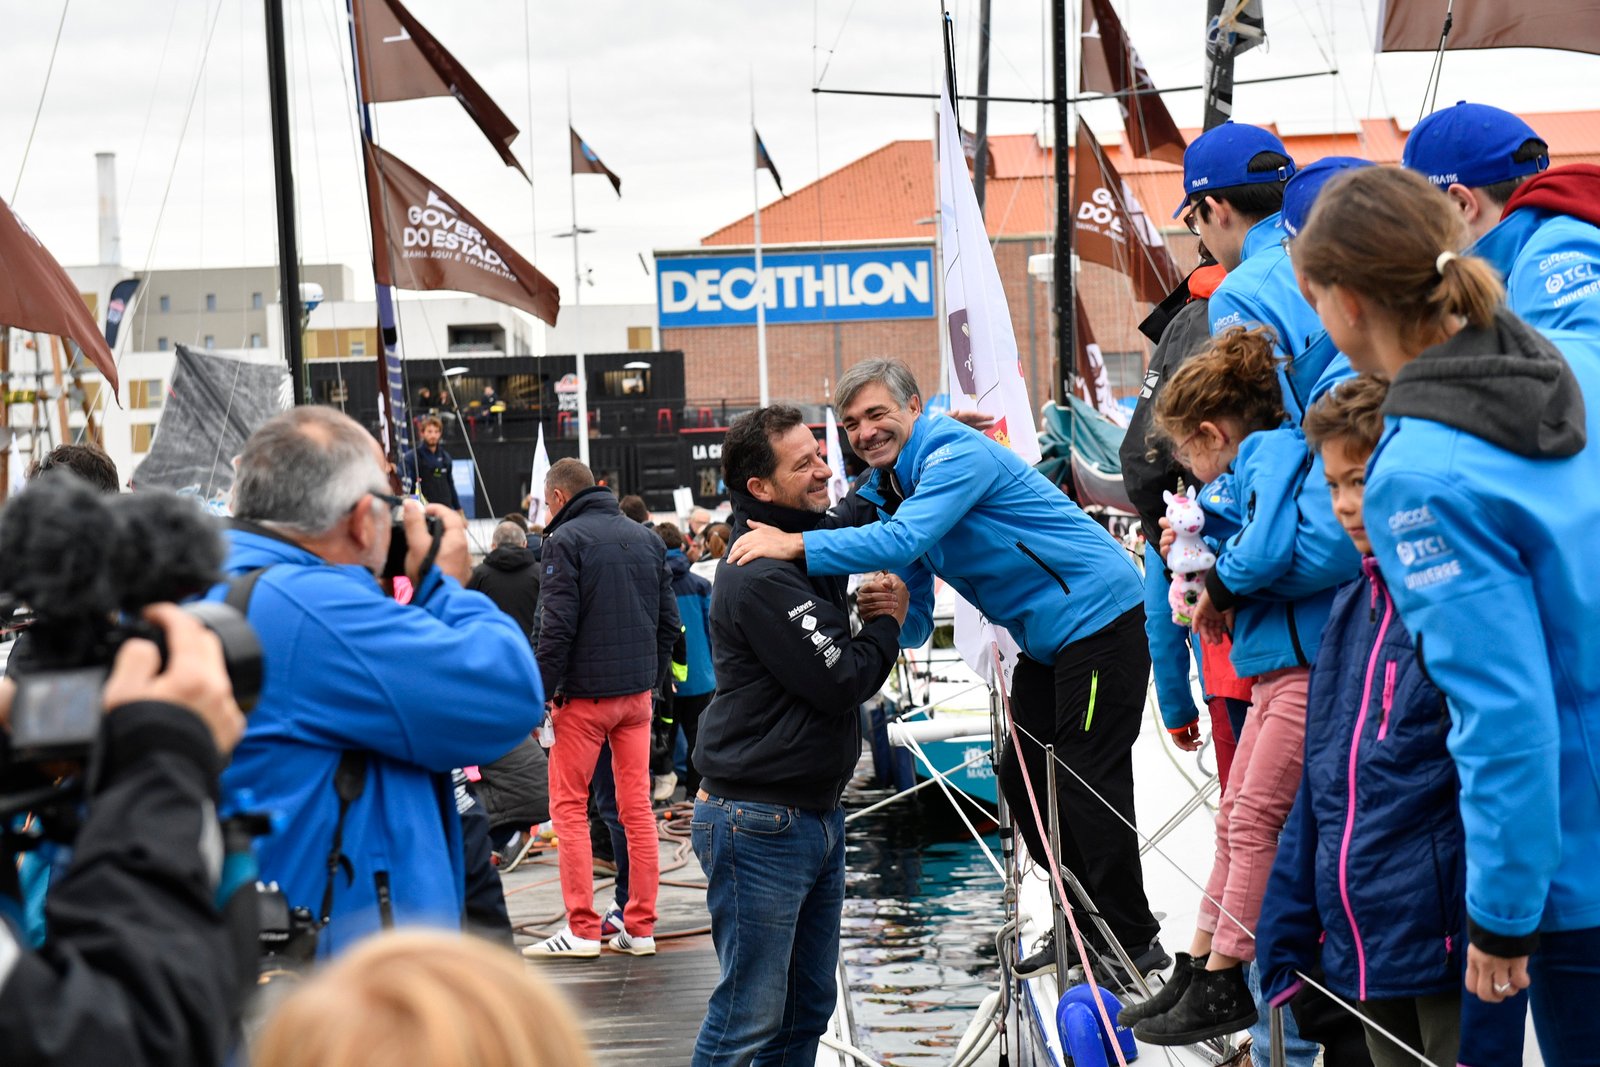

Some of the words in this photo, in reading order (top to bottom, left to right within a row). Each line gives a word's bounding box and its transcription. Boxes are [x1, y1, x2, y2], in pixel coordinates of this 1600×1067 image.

[403, 227, 430, 247] DO
[660, 261, 930, 314] DECATHLON
[1553, 279, 1600, 308] UNIVERR
[692, 445, 708, 460] LA
